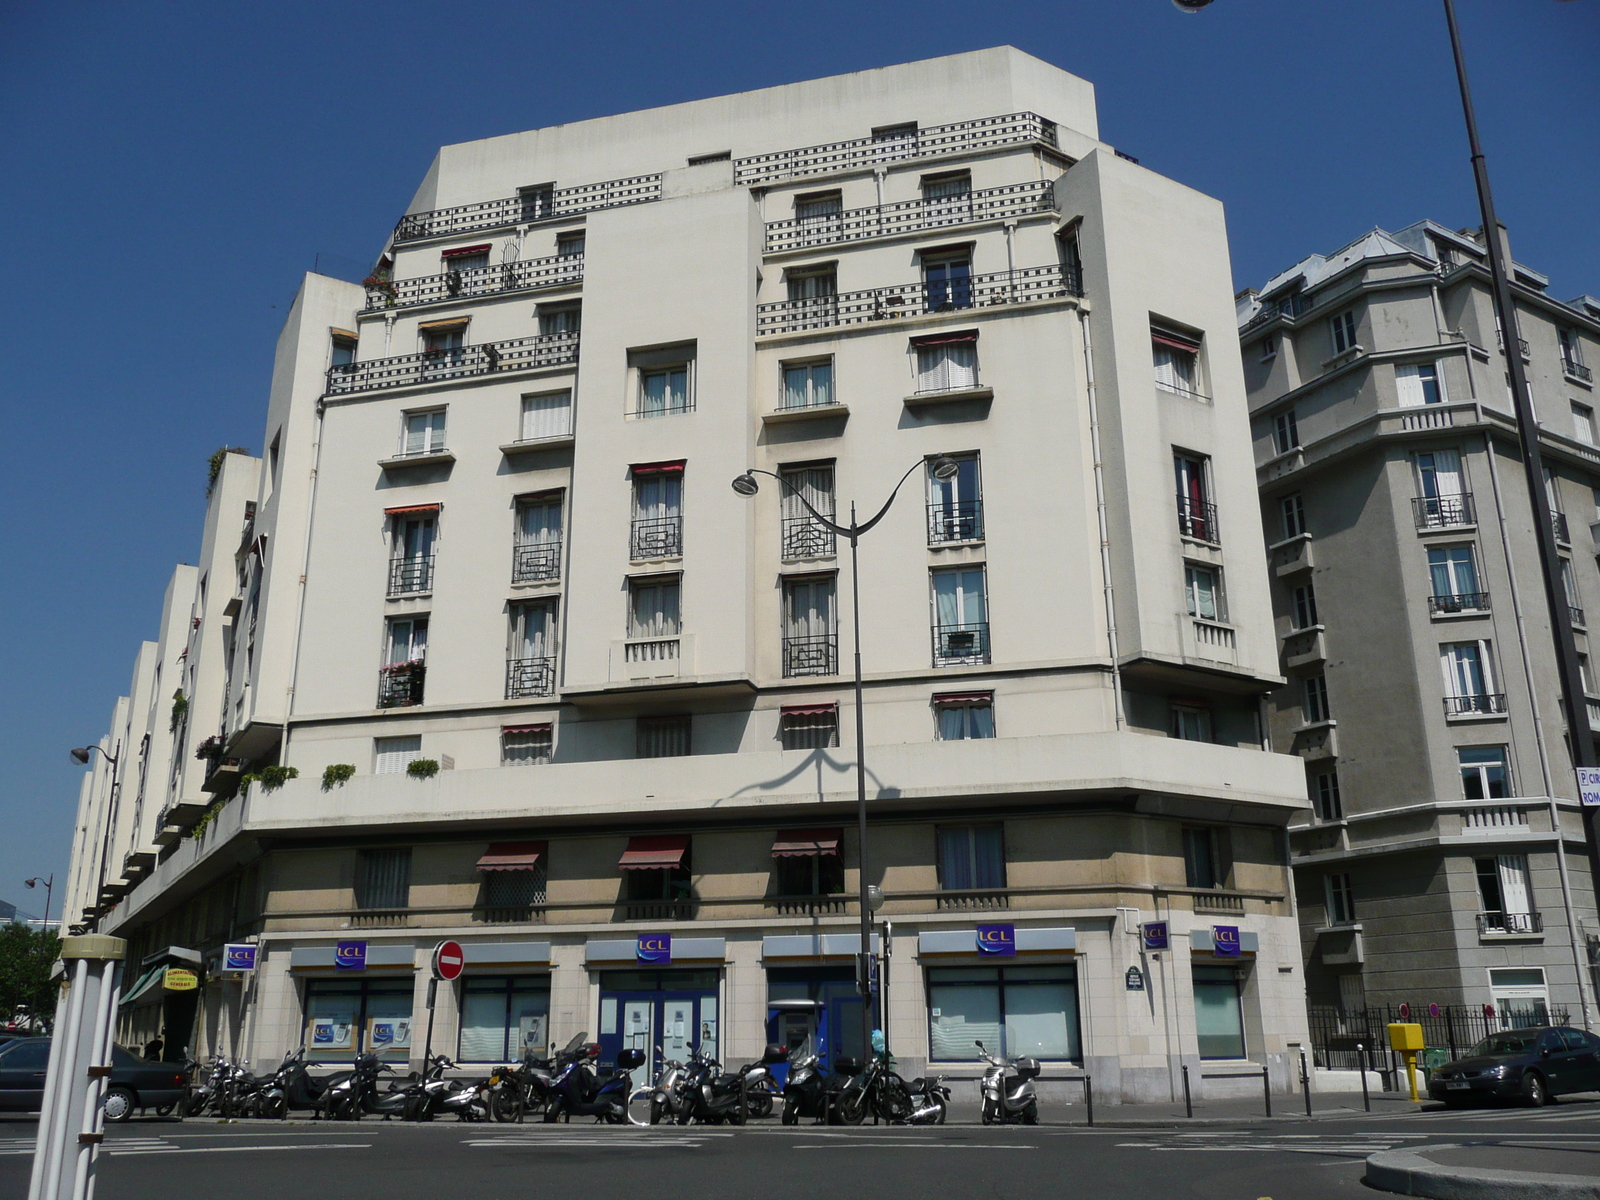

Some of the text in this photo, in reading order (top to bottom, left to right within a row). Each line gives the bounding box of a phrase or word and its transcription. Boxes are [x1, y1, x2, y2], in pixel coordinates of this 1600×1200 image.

[1581, 773, 1586, 783] P
[1583, 792, 1600, 803] ROM
[979, 931, 1010, 941] LCL
[1145, 928, 1165, 938] LCL
[1215, 931, 1236, 942] LCL
[639, 940, 667, 950] LCL
[229, 951, 251, 959] LCL
[337, 947, 362, 957] LCL
